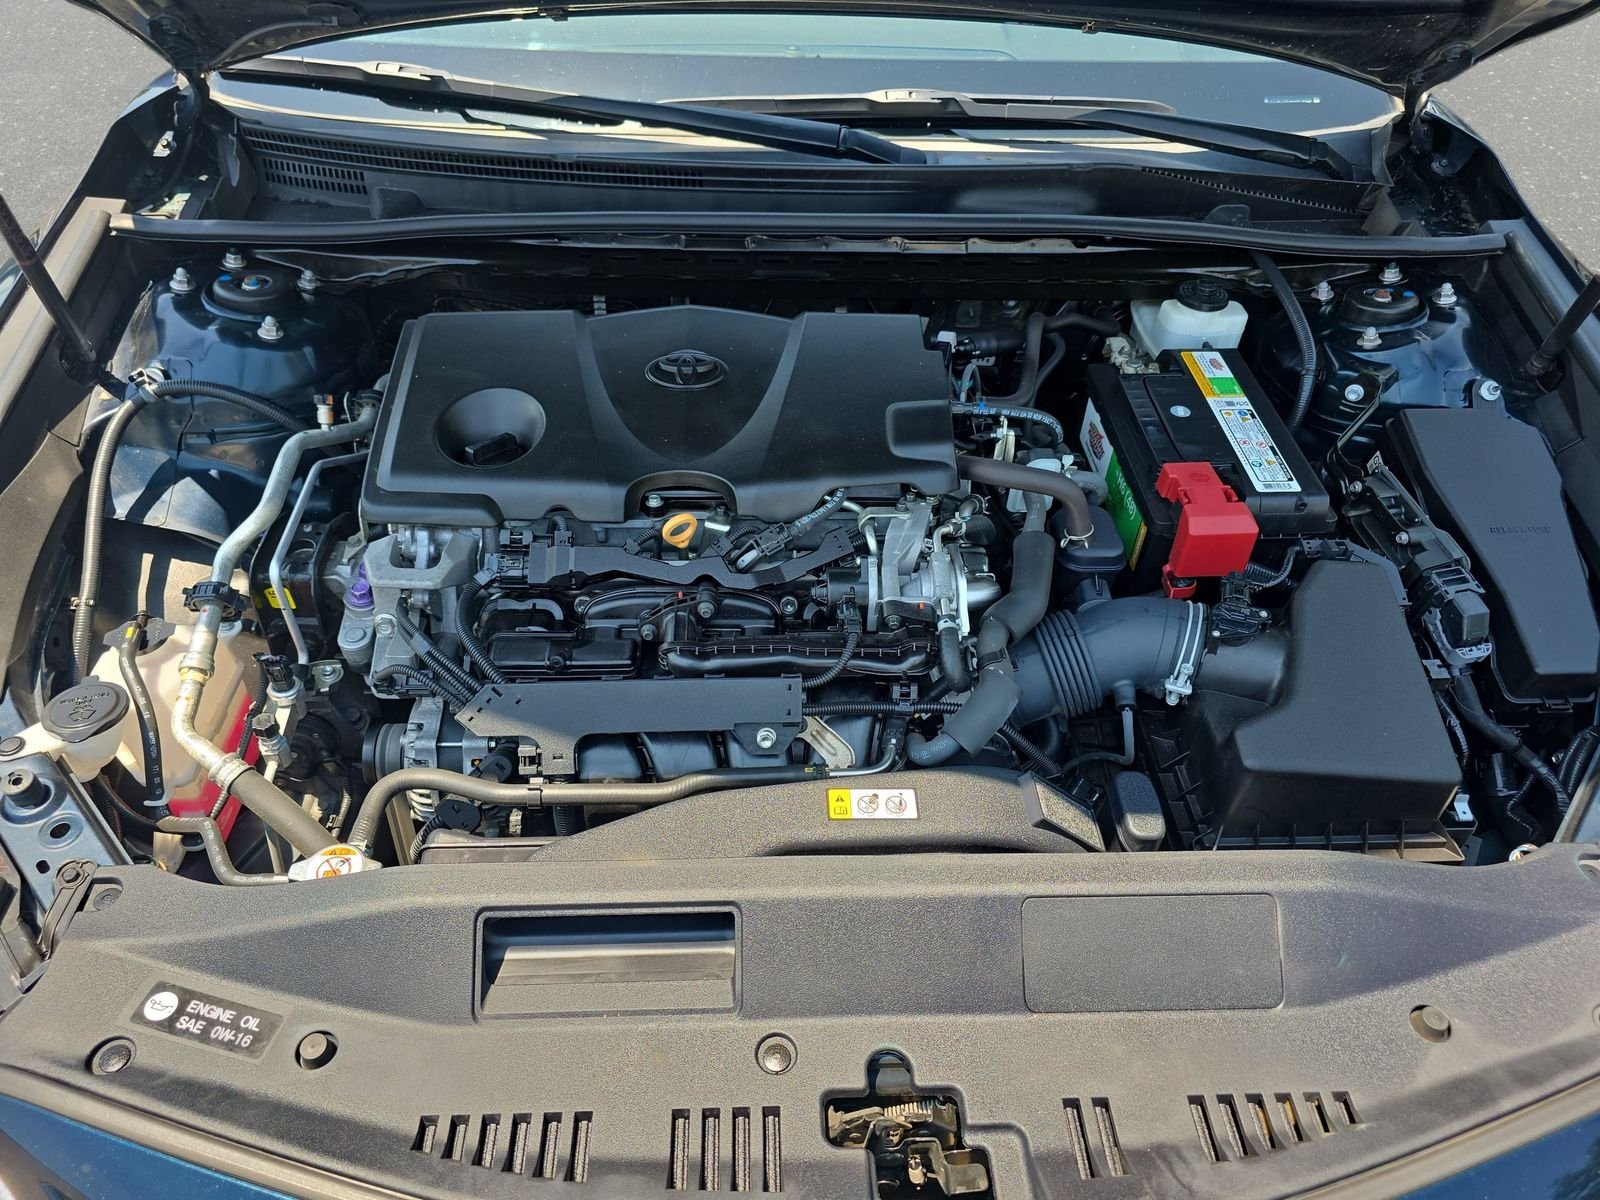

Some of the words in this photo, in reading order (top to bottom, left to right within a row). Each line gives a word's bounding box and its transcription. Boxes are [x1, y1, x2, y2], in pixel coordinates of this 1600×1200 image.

[1489, 526, 1519, 535] RELAY
[175, 1016, 207, 1034] SAE
[210, 1025, 253, 1048] 0W-16
[186, 1000, 237, 1024] ENGINE
[240, 1015, 261, 1032] OIL
